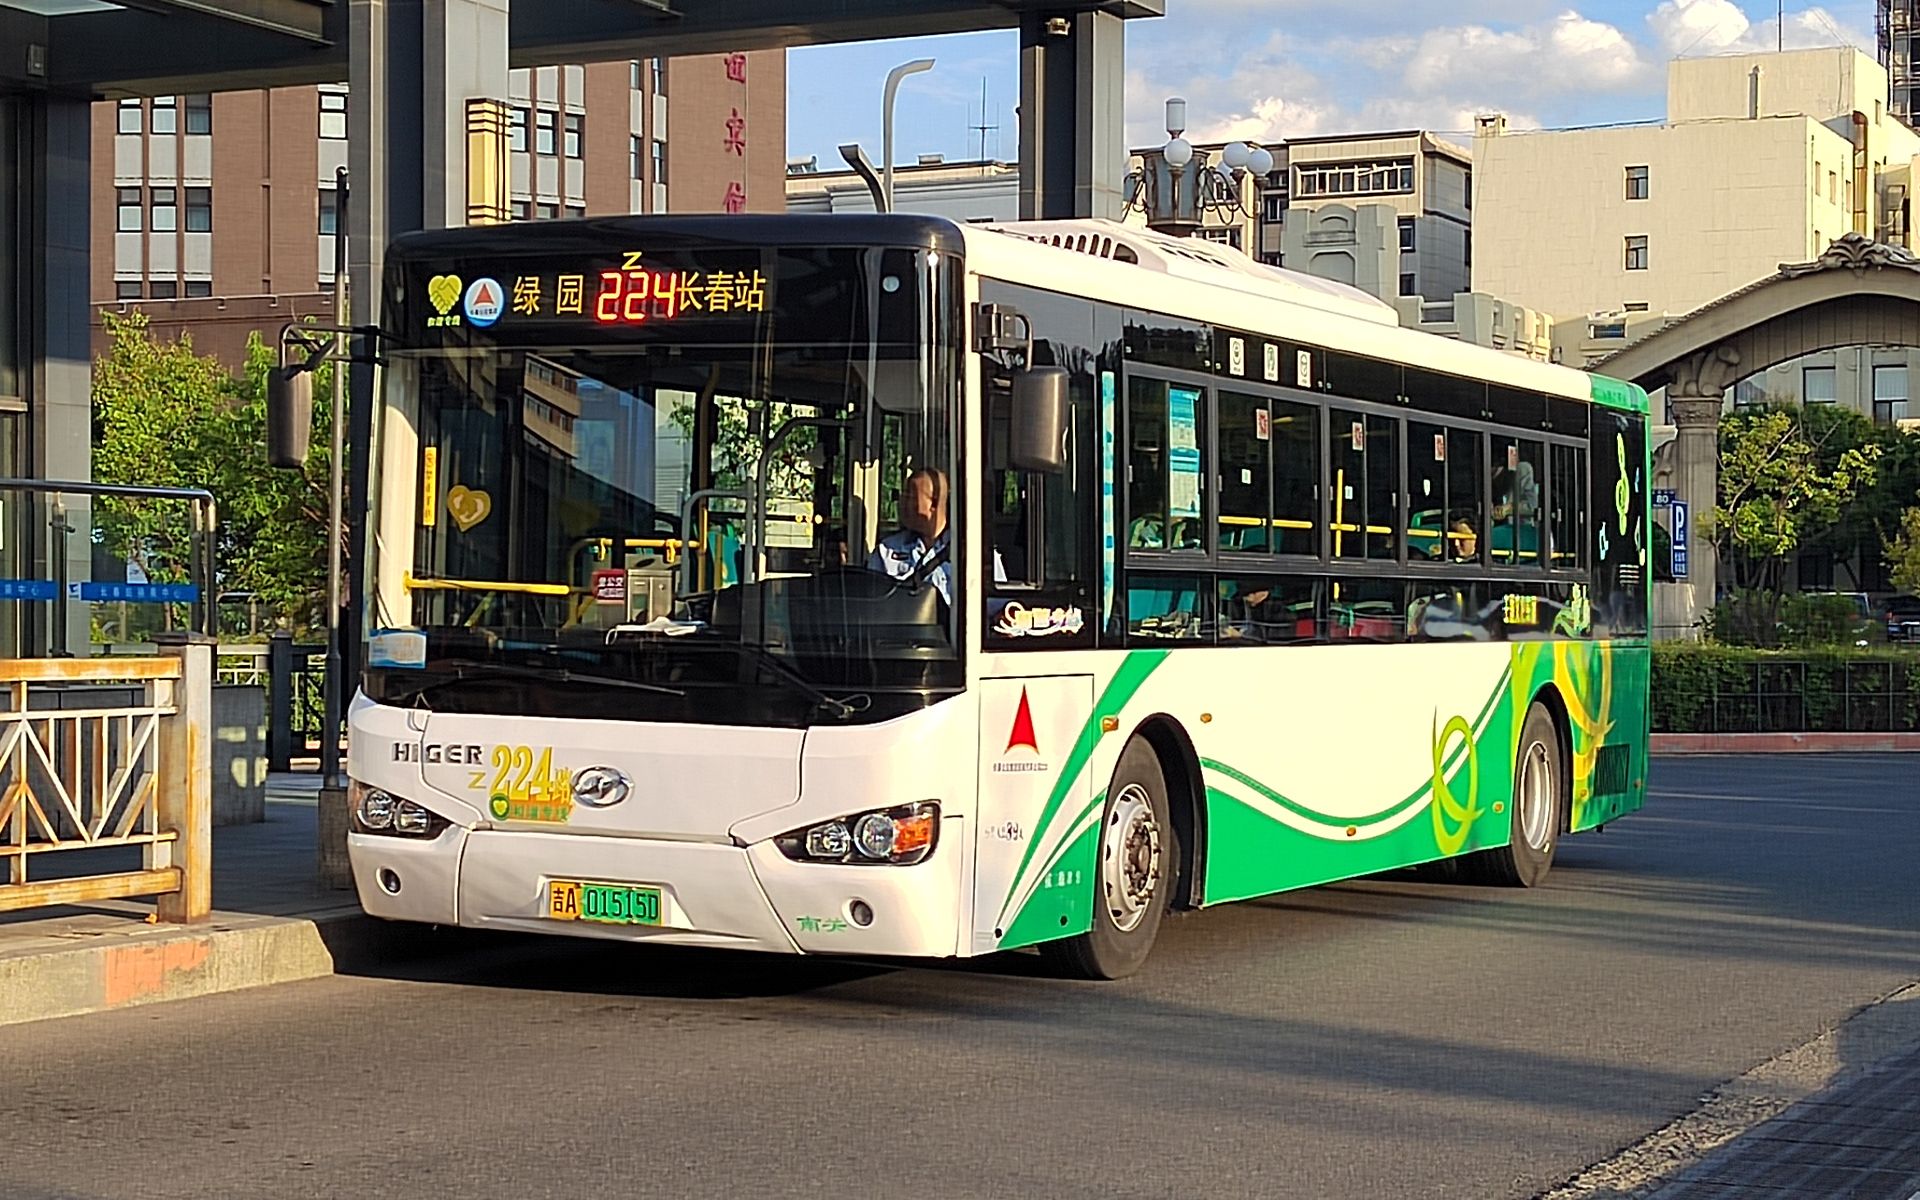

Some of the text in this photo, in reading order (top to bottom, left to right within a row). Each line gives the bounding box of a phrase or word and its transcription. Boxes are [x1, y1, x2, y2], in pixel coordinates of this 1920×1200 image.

[622, 251, 642, 271] Z
[513, 275, 584, 315] 绿园
[598, 271, 677, 320] 224
[676, 269, 766, 313] 长春站
[392, 742, 483, 765] HIGER
[467, 771, 487, 789] Z
[552, 887, 660, 920] 吉A 01515D
